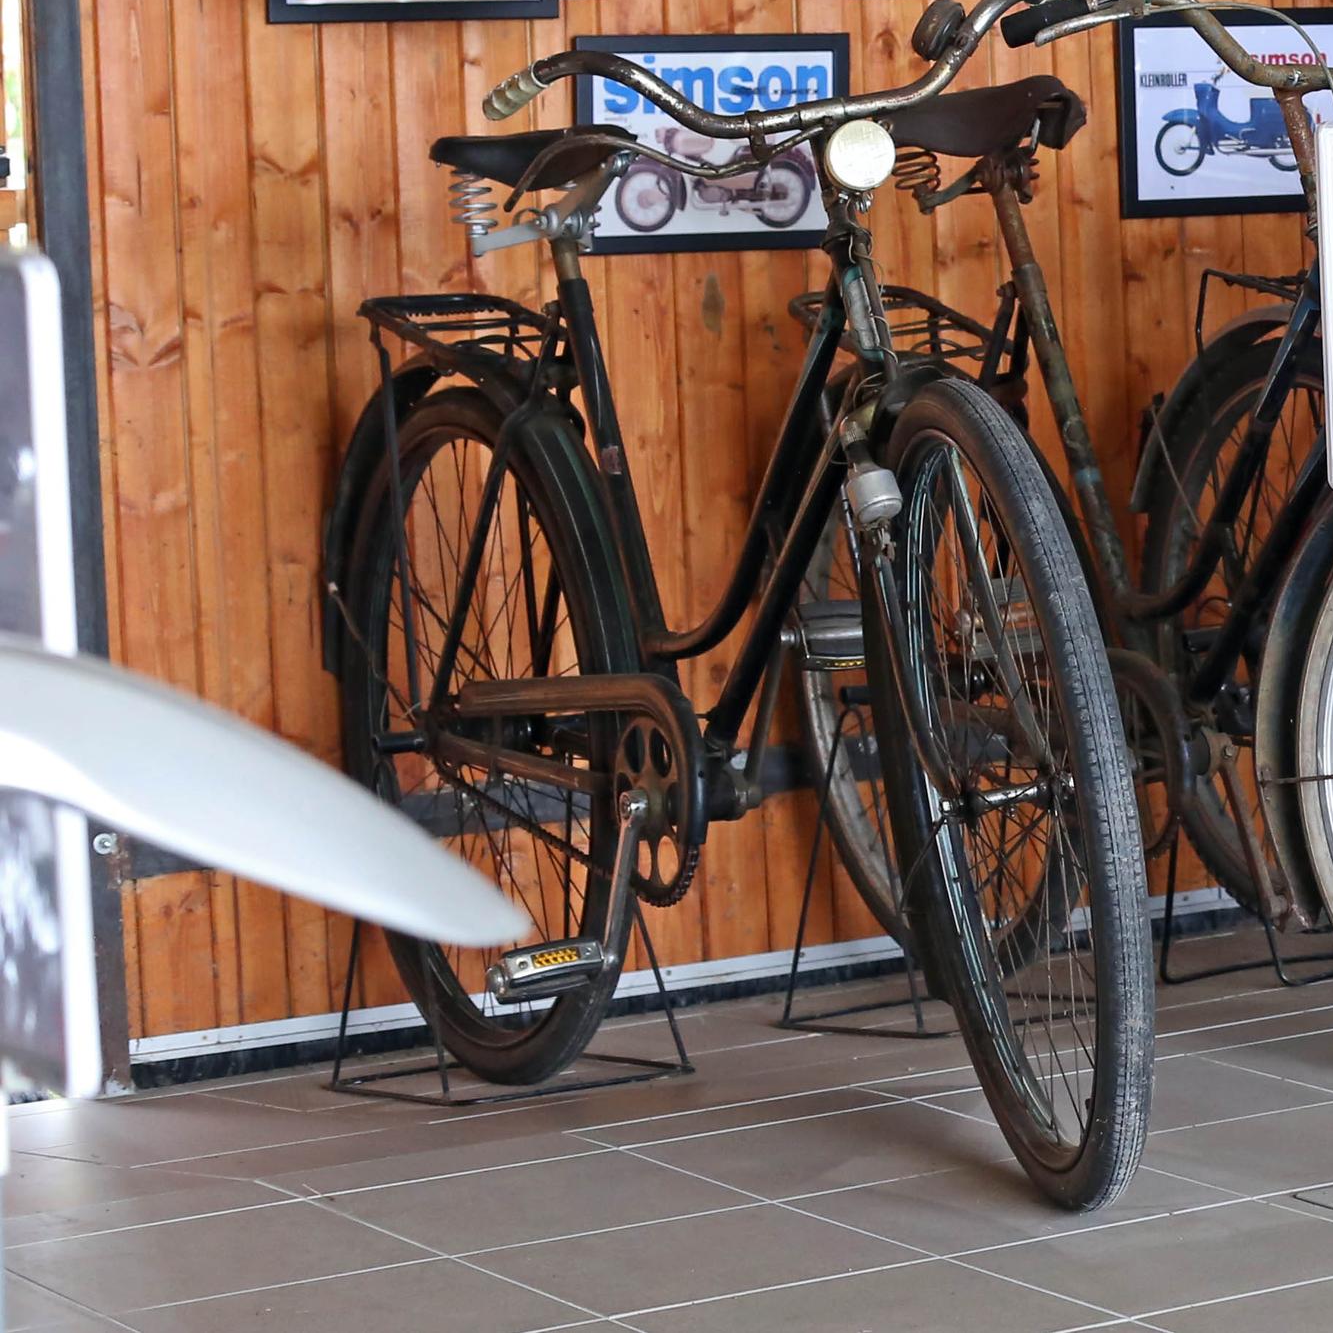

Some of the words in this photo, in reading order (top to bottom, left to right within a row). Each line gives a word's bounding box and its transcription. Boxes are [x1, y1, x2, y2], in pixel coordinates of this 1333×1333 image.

[1250, 52, 1327, 66] simson
[604, 55, 828, 114] simson
[1140, 72, 1188, 88] KLEINROLLER
